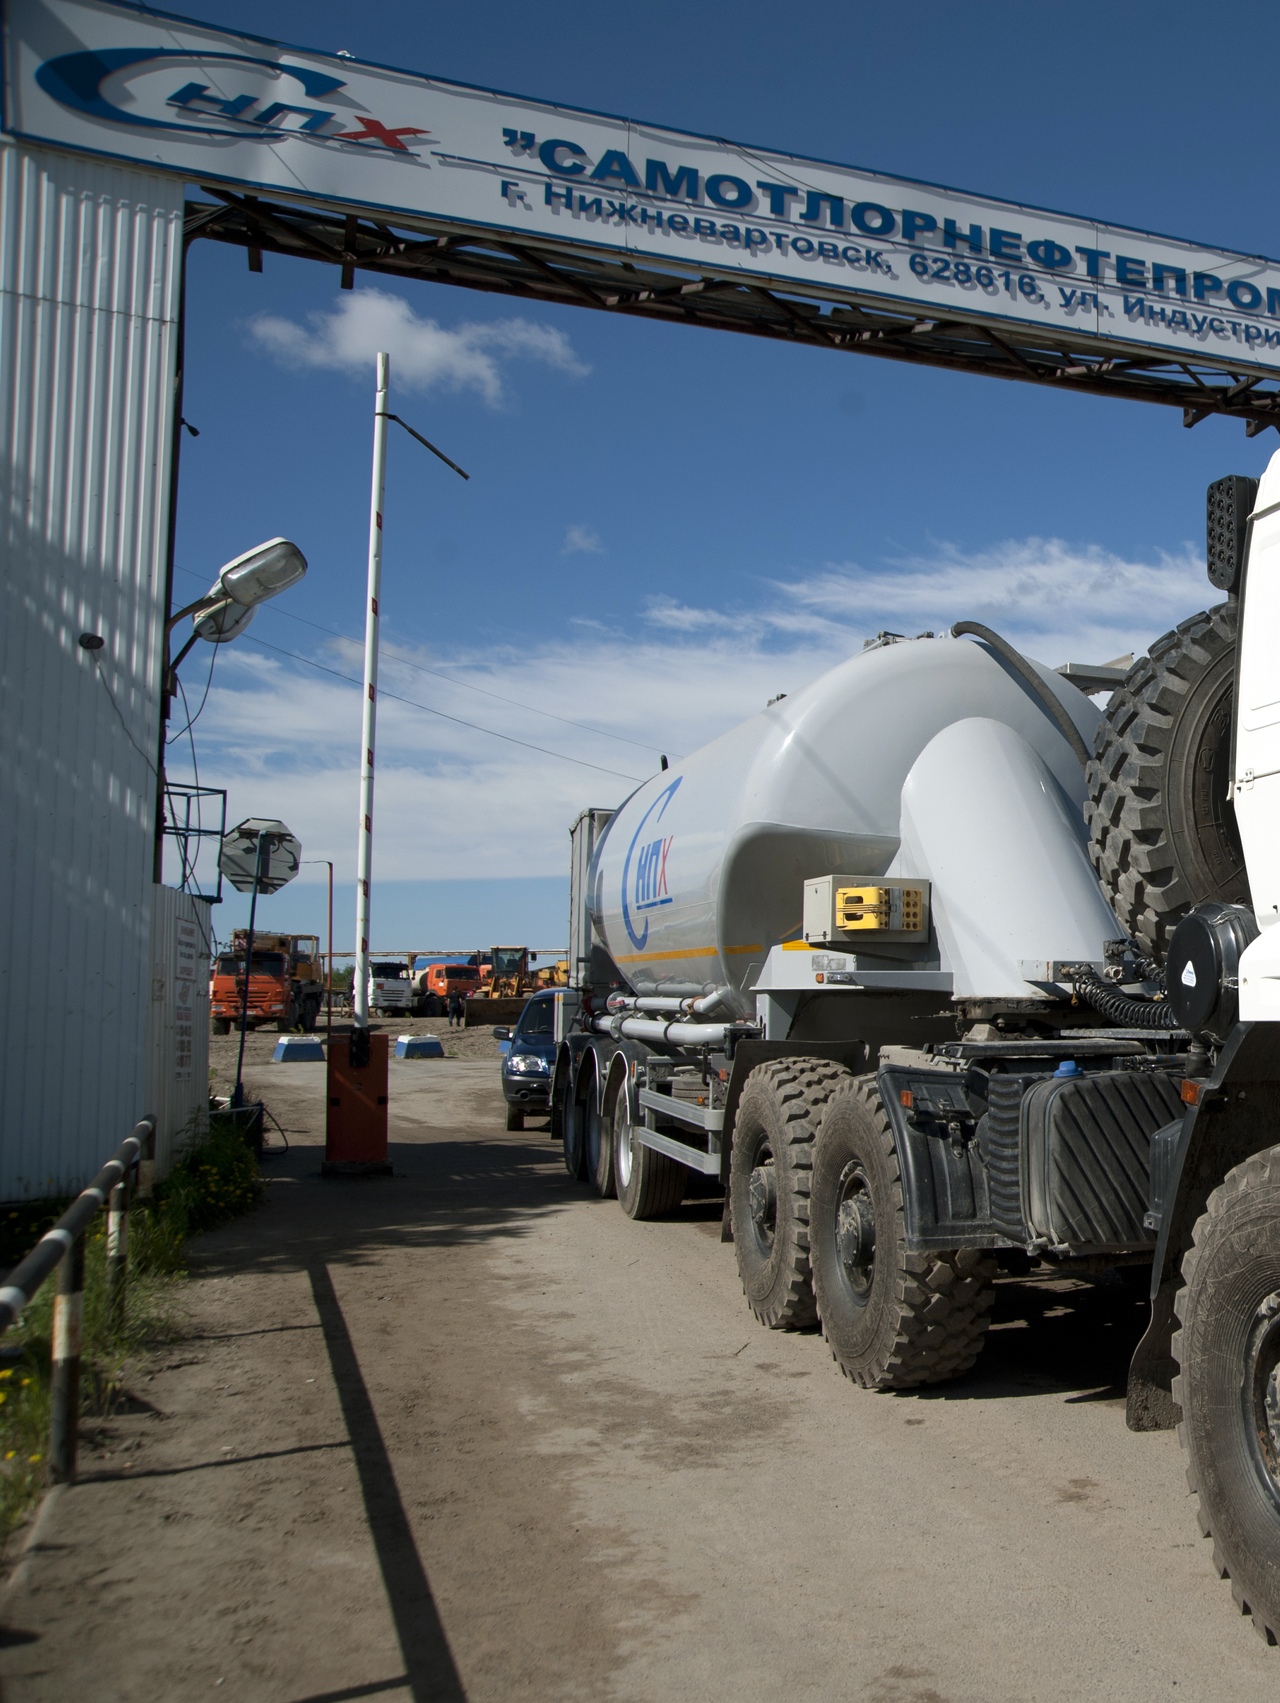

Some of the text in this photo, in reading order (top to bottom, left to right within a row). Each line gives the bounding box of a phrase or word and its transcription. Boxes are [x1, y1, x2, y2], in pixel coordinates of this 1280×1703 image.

[545, 182, 893, 274] Нижневартовск,
[909, 253, 1045, 302] 628616,
[1058, 286, 1109, 310] ул.
